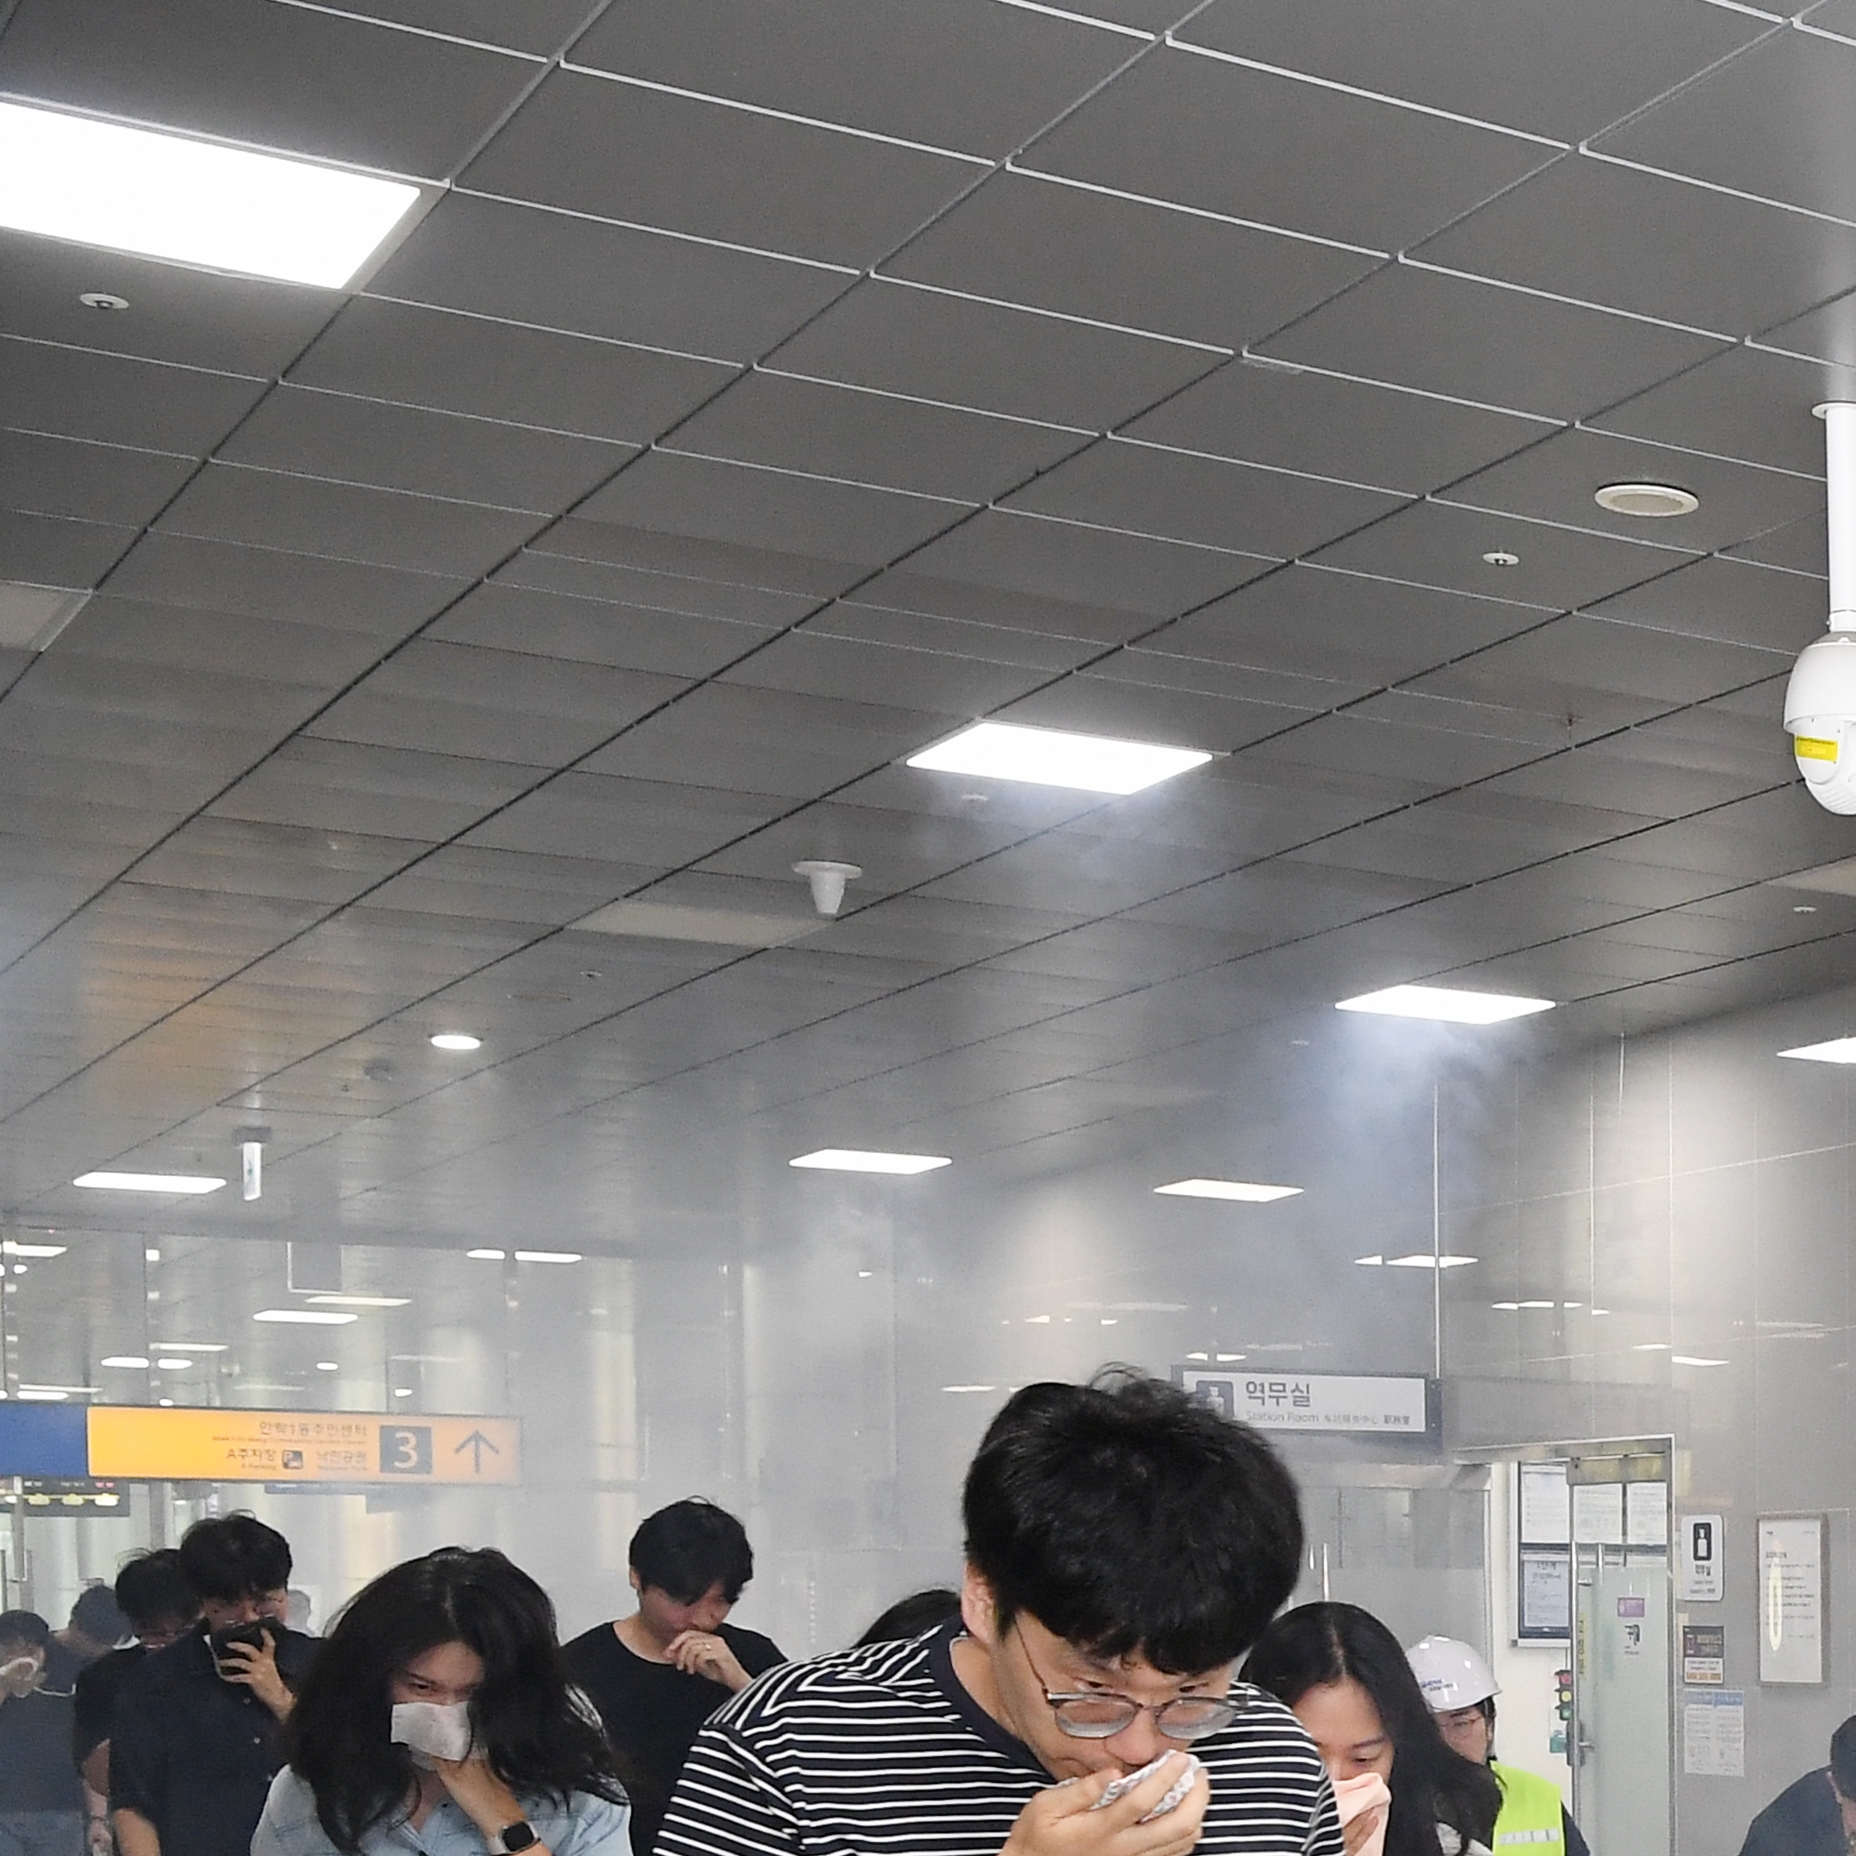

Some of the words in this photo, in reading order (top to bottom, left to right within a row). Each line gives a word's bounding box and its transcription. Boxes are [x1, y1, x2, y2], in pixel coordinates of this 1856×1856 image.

[1245, 1380, 1311, 1408] 역무실
[1245, 1410, 1284, 1423] Station
[1287, 1411, 1320, 1423] Room
[393, 1431, 419, 1468] 3
